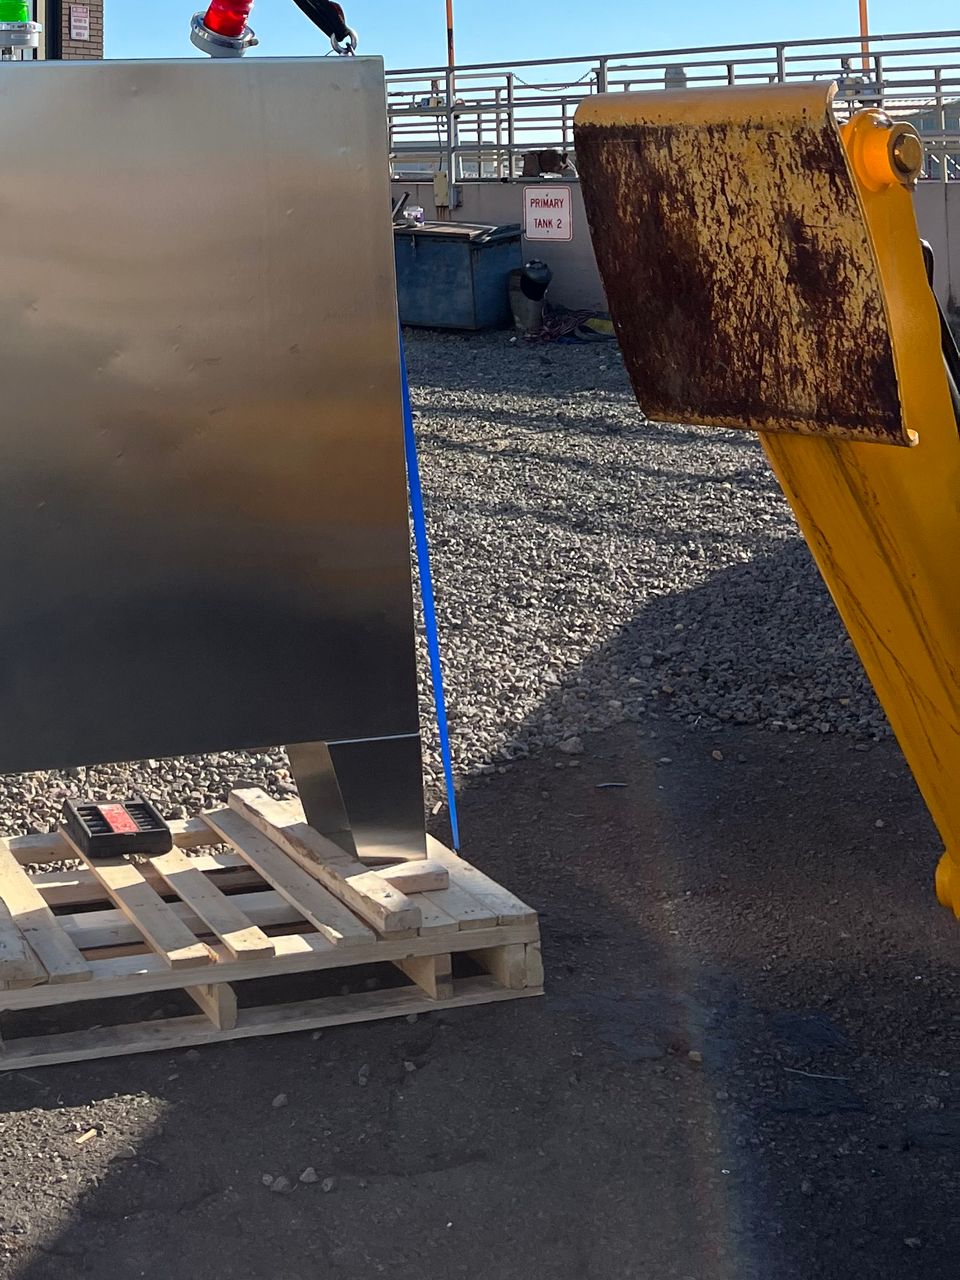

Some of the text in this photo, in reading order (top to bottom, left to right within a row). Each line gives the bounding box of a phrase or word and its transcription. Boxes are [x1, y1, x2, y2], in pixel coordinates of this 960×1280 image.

[530, 198, 564, 208] PRIMARY
[534, 218, 562, 229] TANK 2
